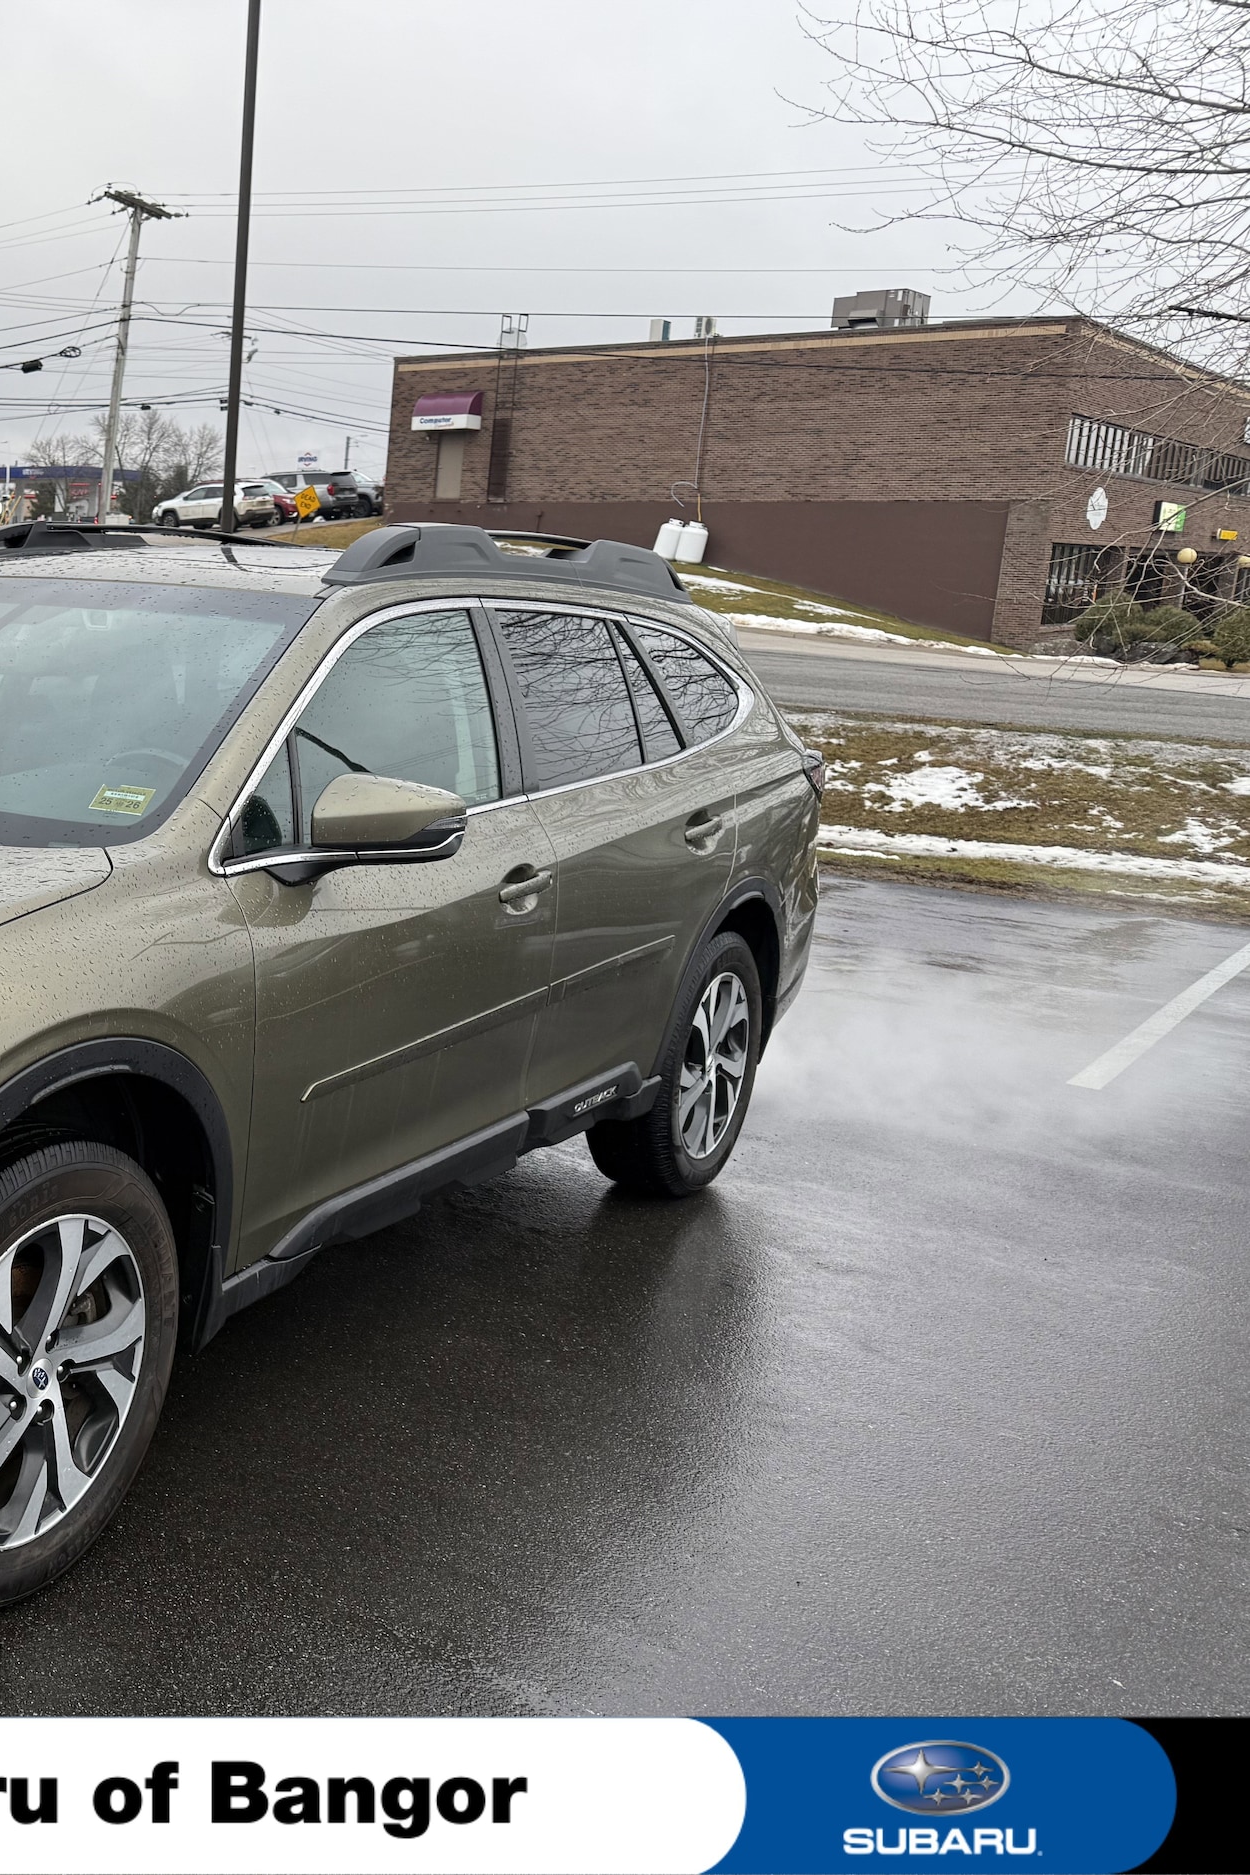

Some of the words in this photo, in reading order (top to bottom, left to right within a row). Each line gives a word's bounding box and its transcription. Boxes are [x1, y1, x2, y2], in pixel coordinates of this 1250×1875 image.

[419, 417, 452, 425] Computer
[300, 493, 316, 502] DEAD
[300, 501, 311, 509] END
[99, 797, 113, 806] 25
[125, 800, 141, 810] 26
[574, 1085, 618, 1113] OUTBACK
